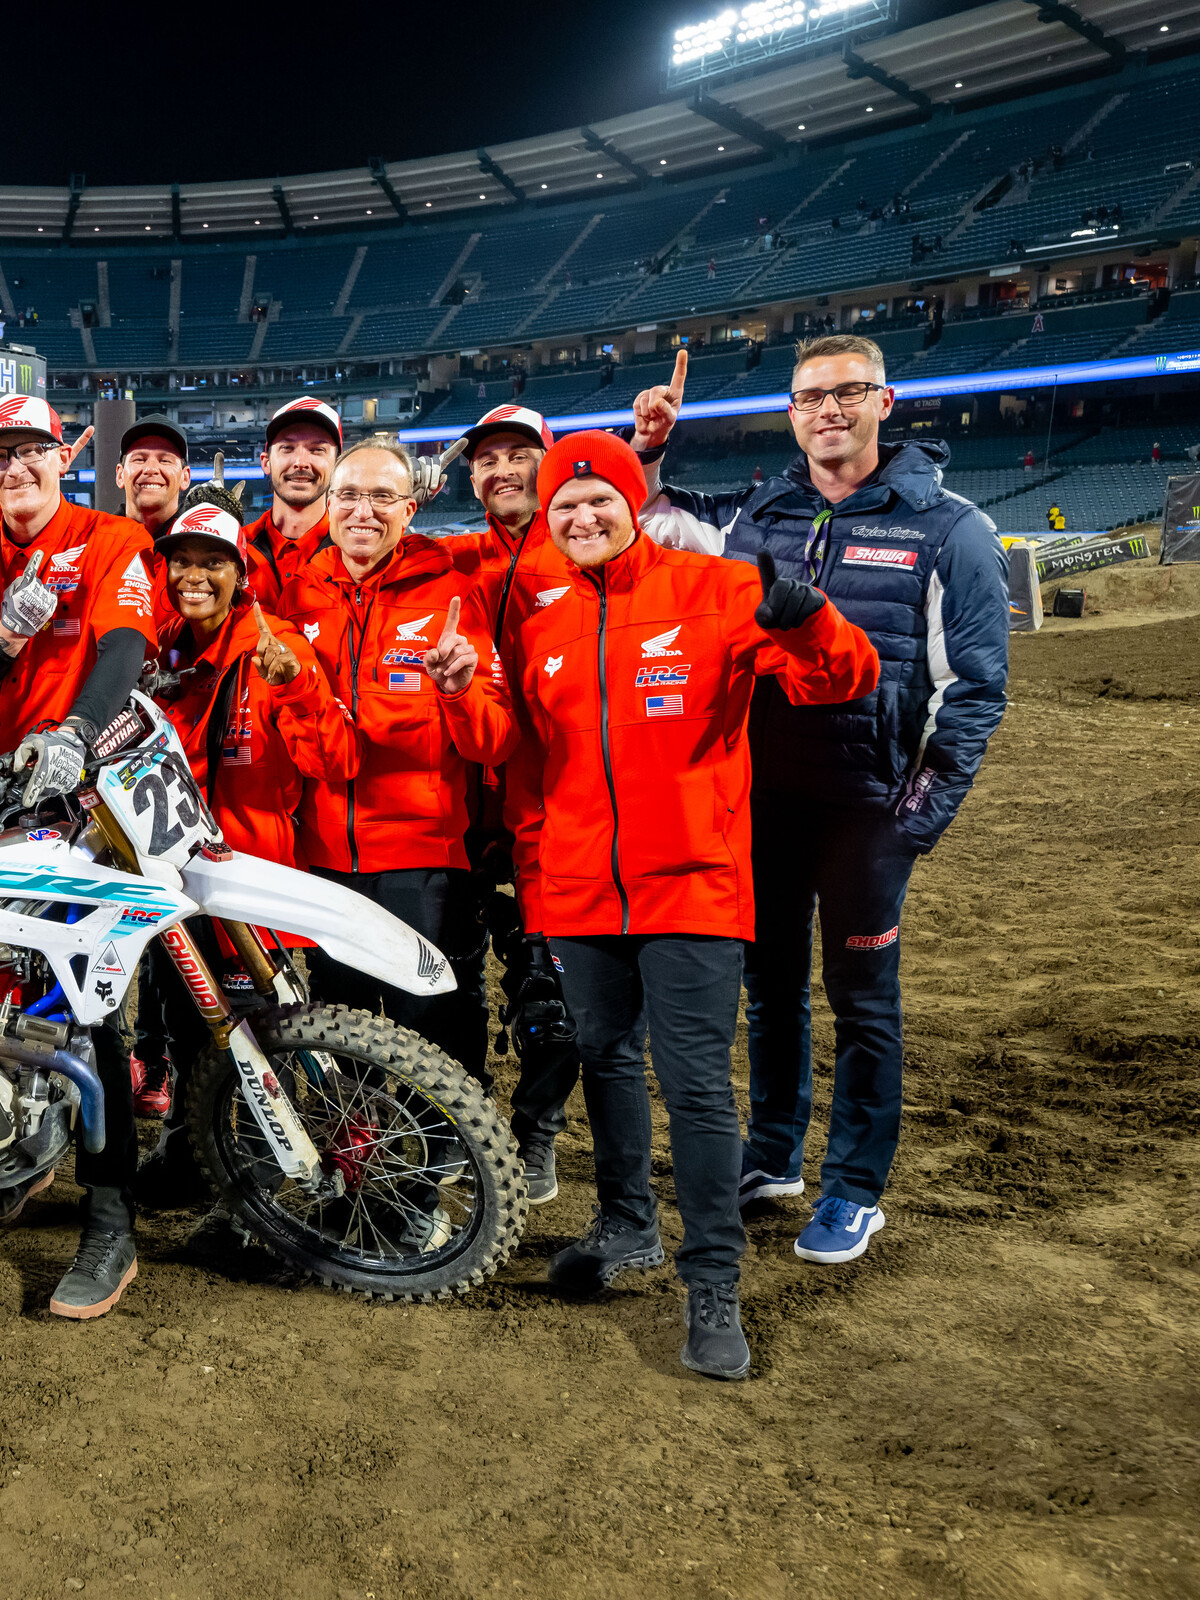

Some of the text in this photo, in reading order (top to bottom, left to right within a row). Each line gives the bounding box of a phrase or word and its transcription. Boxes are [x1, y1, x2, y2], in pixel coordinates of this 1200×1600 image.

[854, 549, 908, 562] SHOWA
[1052, 545, 1124, 568] MONSTER
[1065, 558, 1114, 573] ENERGY
[124, 580, 151, 591] SHOWA
[641, 650, 683, 658] HONDA
[635, 664, 692, 684] HRC
[97, 719, 140, 759] RENTHAL
[132, 750, 201, 856] 23
[29, 830, 50, 841] VP
[121, 908, 162, 924] HRC
[845, 925, 898, 949] SHOWA
[161, 929, 220, 1011] SHOWA
[428, 957, 448, 988] HONDA
[237, 1060, 294, 1152] DUNLOP
